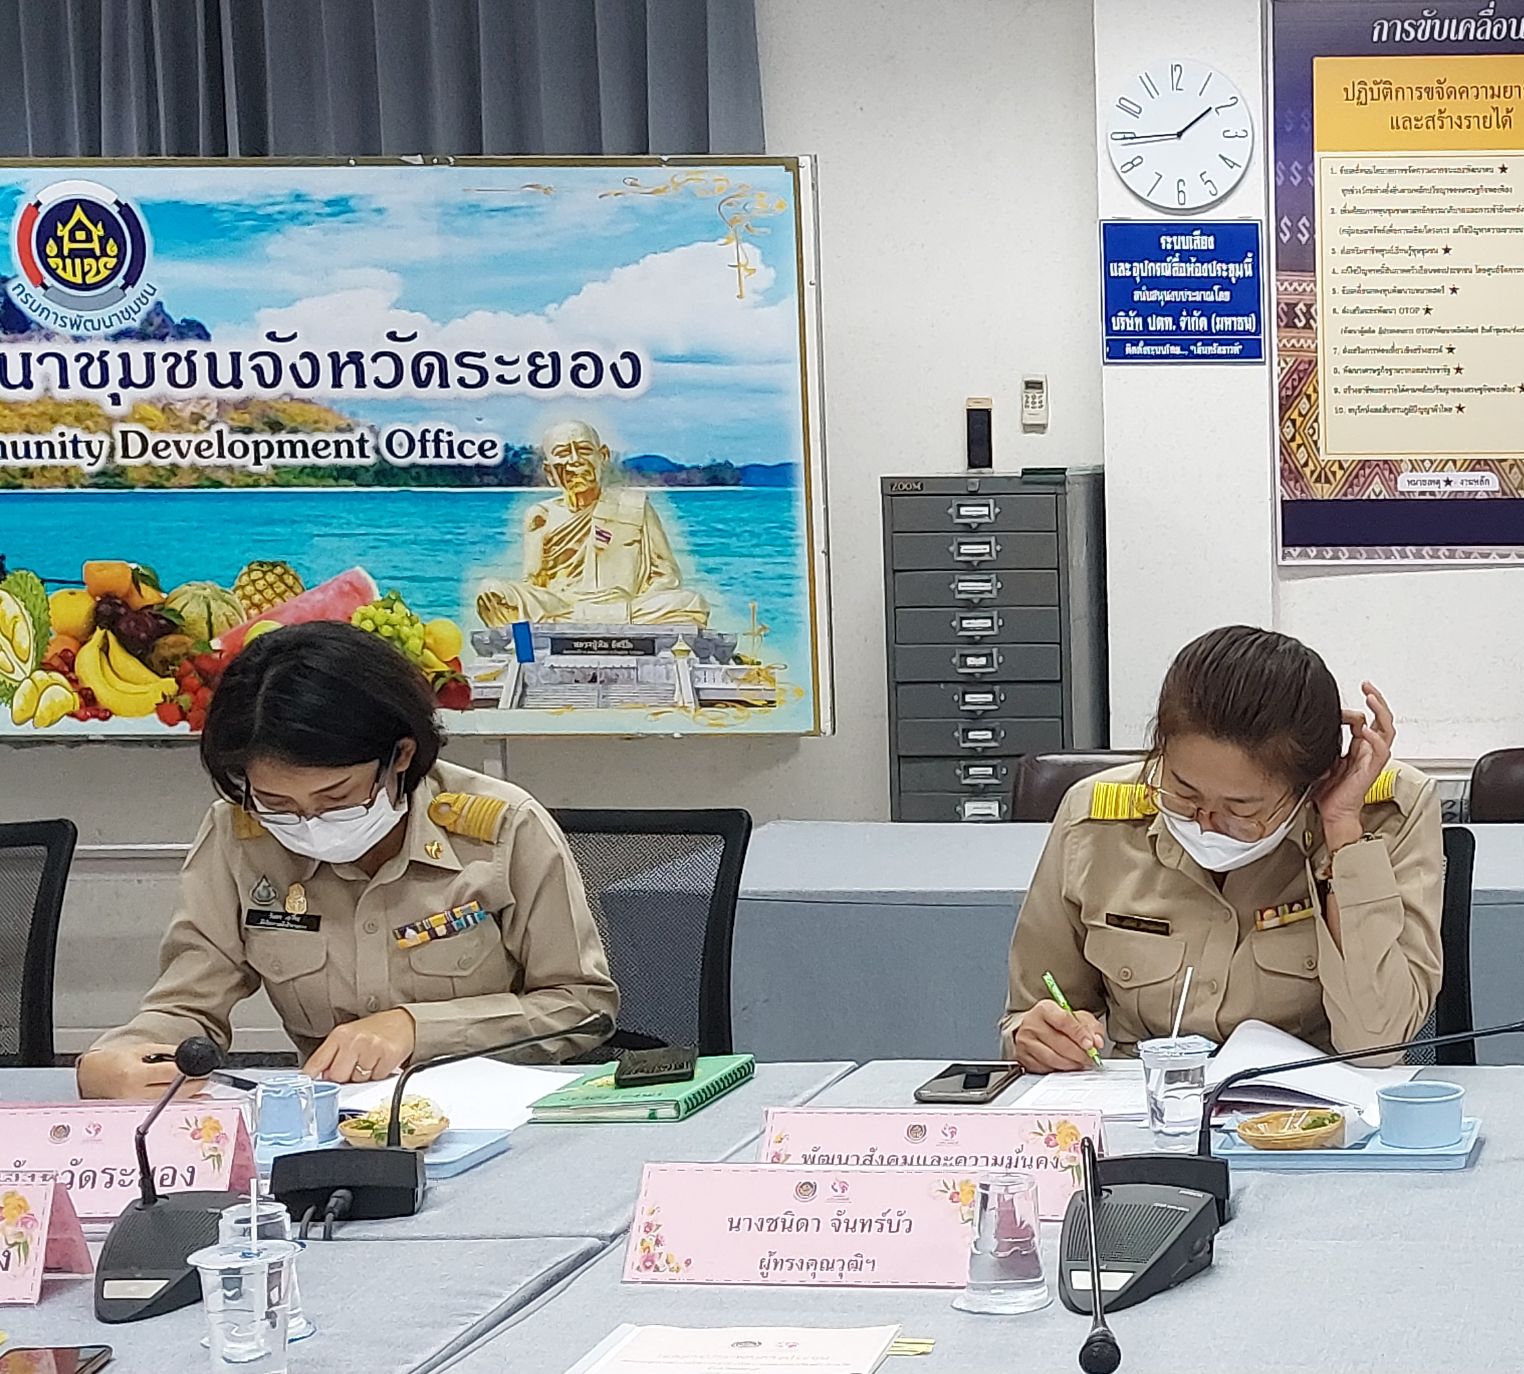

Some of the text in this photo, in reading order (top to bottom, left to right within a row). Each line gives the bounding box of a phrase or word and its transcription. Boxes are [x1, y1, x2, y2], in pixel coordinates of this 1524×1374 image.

[1171, 64, 1184, 91] 12
[1199, 72, 1212, 96] 1
[1116, 96, 1142, 118] 10
[1215, 96, 1239, 116] 2
[1390, 107, 1513, 131] และสร้างรายได้
[1222, 129, 1248, 138] 3
[1120, 155, 1143, 173] 8
[1218, 153, 1241, 169] 4
[1146, 171, 1162, 197] 7
[1177, 178, 1186, 205] 6
[1199, 171, 1218, 196] 5
[1160, 230, 1215, 250] ระบบเสียง
[11, 282, 158, 332] กรมการพัฒนาชุมชน
[1112, 310, 1143, 331] บริษัท
[1179, 308, 1208, 331] จำกัด
[1211, 313, 1256, 334] (มหาชน)
[119, 429, 370, 466] Development
[385, 428, 498, 460] Office
[727, 1208, 913, 1235] นางชนิดา จันทร์บัว
[759, 1250, 877, 1280] ผู้ทรงคุณวุฒิฯ
